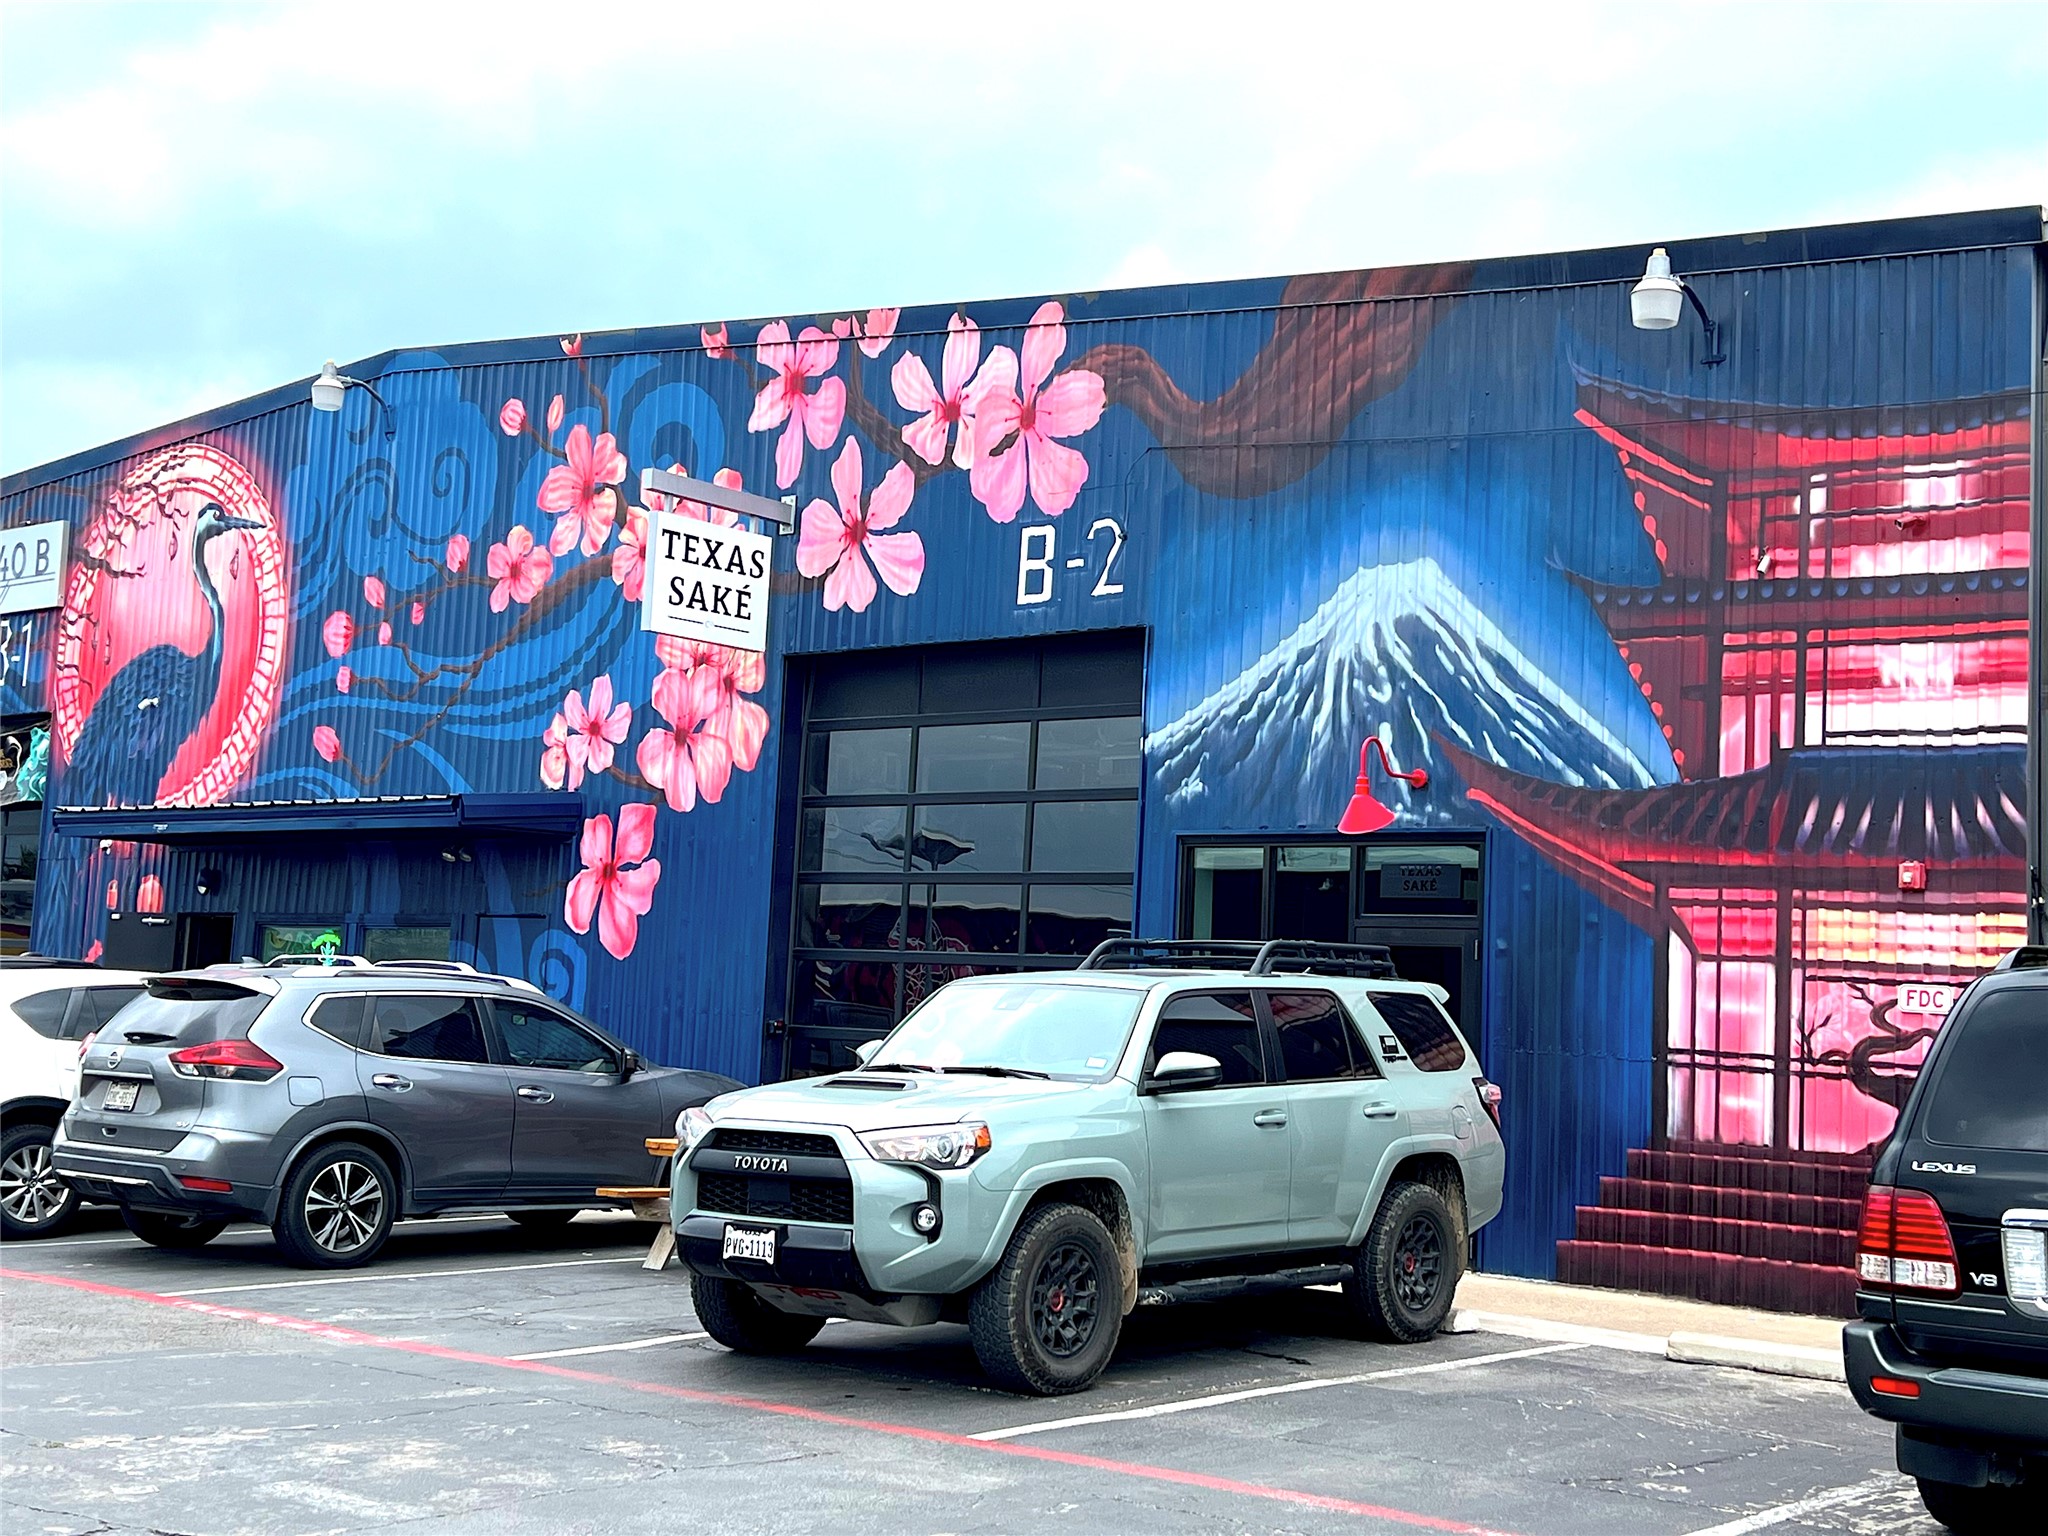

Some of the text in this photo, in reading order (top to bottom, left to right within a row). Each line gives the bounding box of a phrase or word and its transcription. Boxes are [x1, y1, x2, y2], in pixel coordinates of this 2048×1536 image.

[35, 538, 50, 576] B
[662, 528, 765, 579] TEXAS
[1017, 517, 1124, 605] B-2
[668, 576, 752, 620] SAKÉ
[1400, 865, 1442, 877] TEXAS
[1403, 878, 1438, 891] SAKÉ
[1906, 989, 1944, 1008] FDC
[734, 1155, 788, 1172] TOYOTA
[1911, 1160, 1976, 1175] LEXUS
[1969, 1271, 1998, 1287] V8
